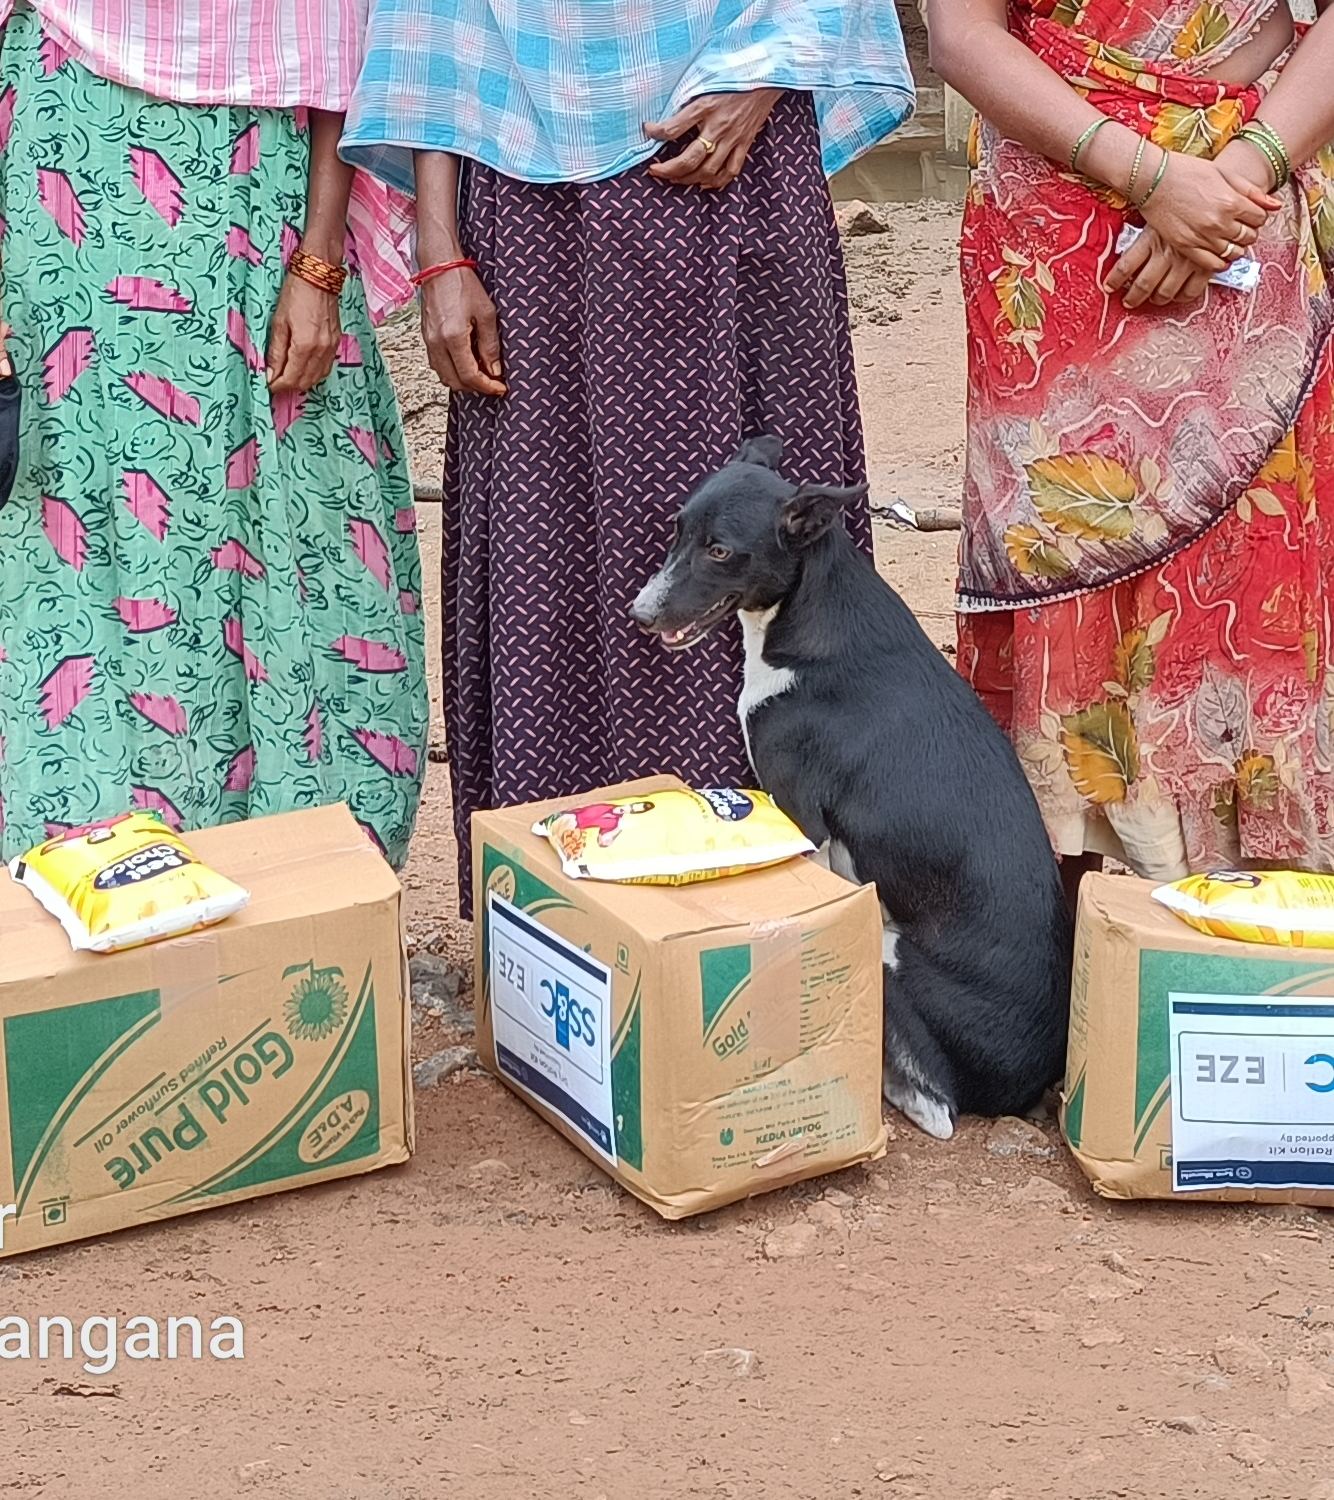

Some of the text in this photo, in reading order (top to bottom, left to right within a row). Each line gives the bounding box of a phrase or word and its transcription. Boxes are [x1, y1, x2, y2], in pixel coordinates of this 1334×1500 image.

[98, 844, 176, 886] Choice
[125, 854, 183, 881] Best
[497, 950, 597, 1048] SS&C EZE
[712, 1018, 750, 1057] Gold
[1195, 1053, 1266, 1085] EZE
[93, 1035, 230, 1156] Refined Sunflower Oil
[103, 1030, 295, 1192] Gold Pure
[1269, 1145, 1286, 1156] Kit
[1290, 1146, 1333, 1157] Ration
